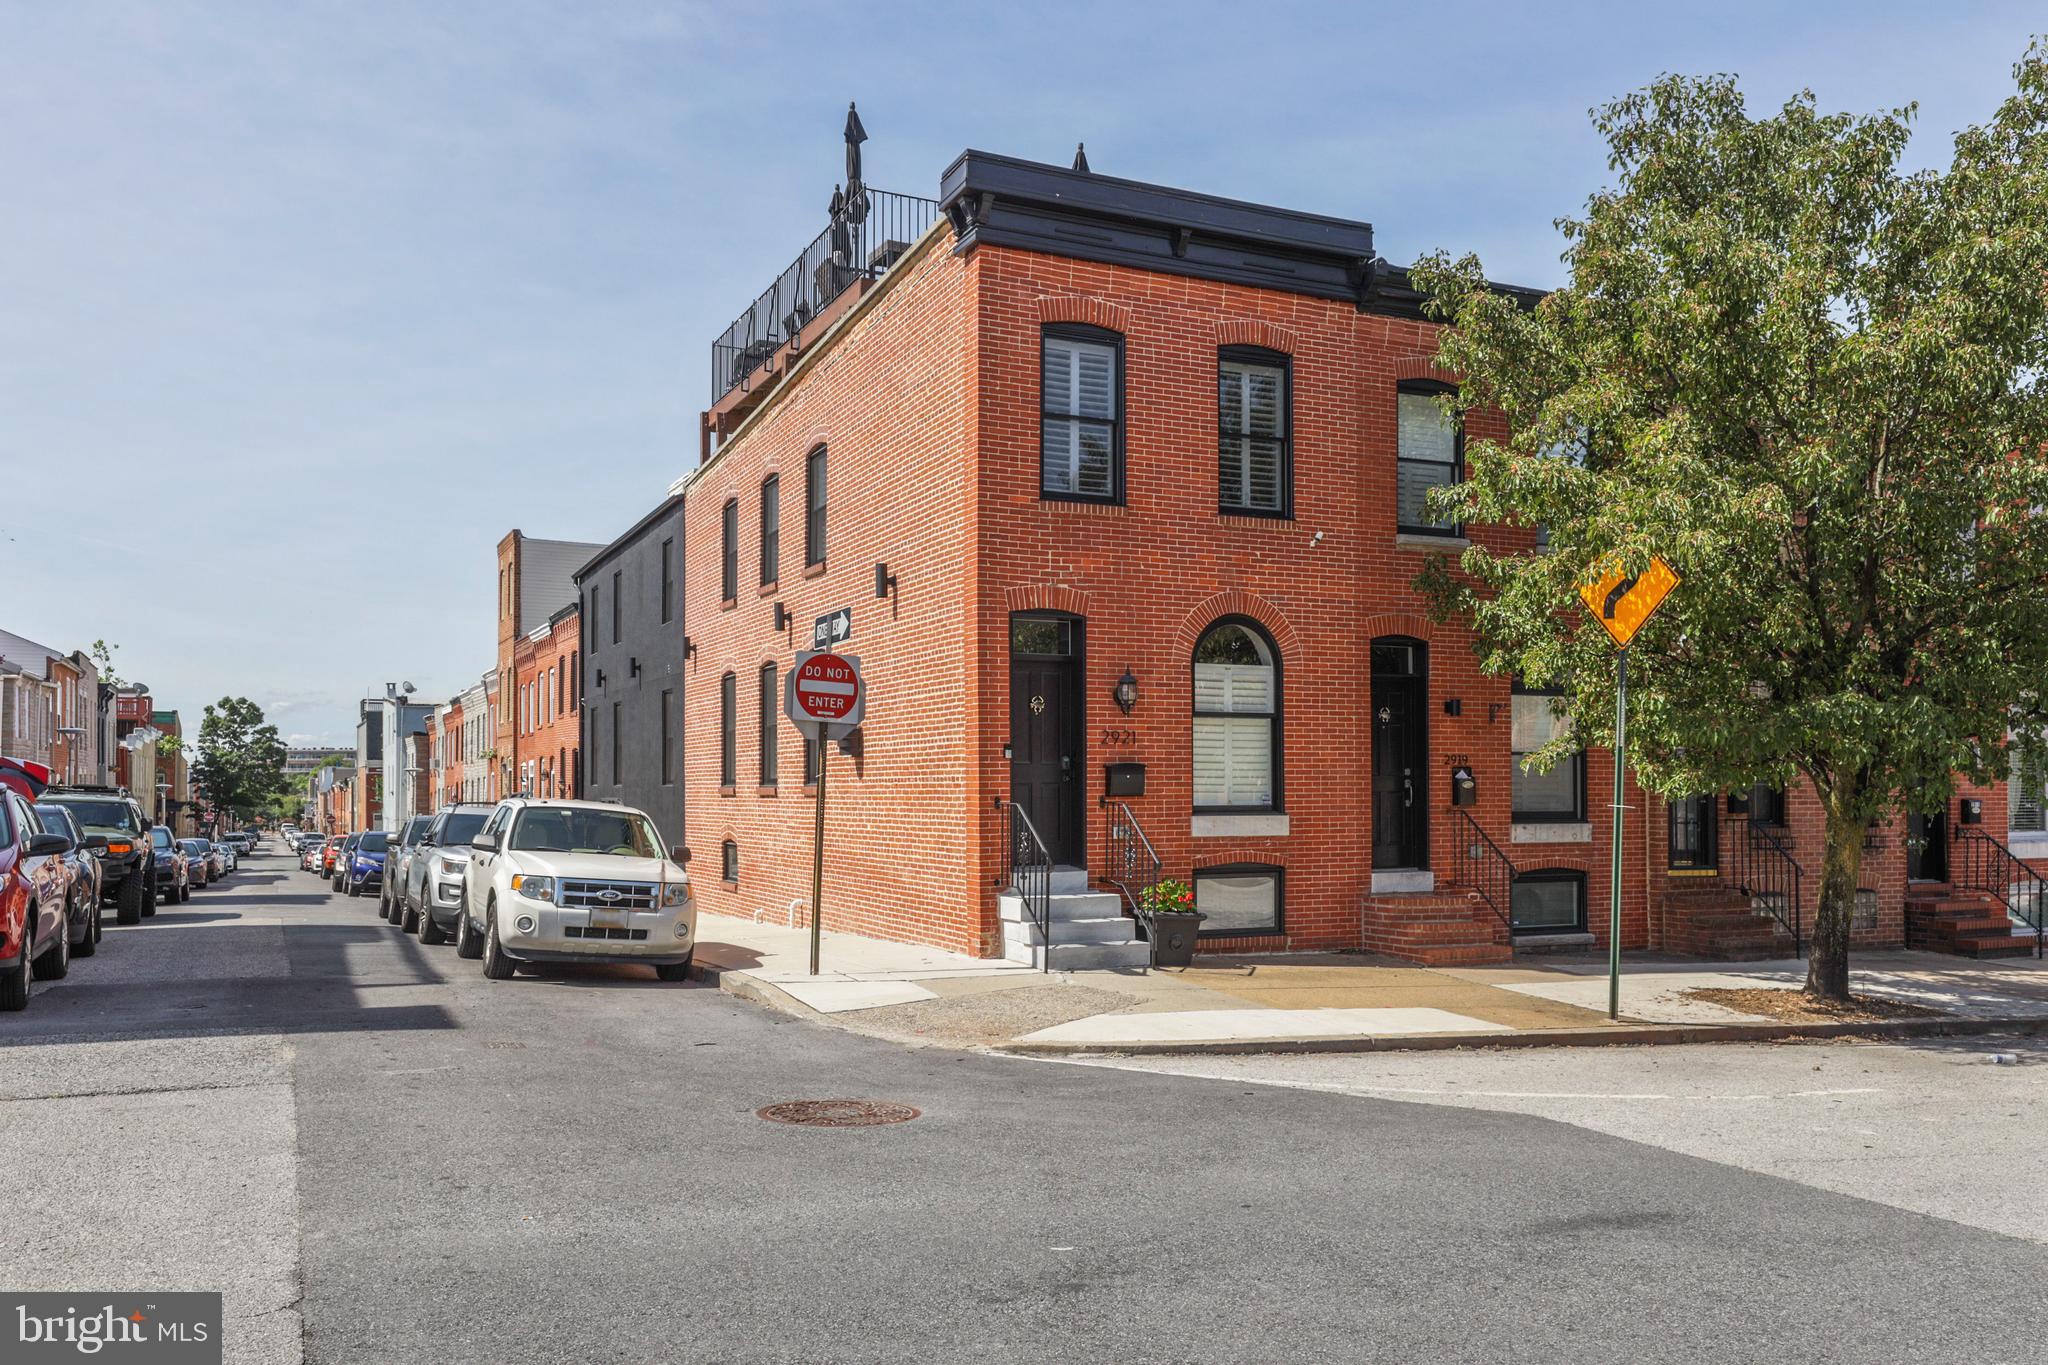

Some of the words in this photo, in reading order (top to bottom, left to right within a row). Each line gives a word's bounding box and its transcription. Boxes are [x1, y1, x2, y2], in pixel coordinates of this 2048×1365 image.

[805, 666, 821, 677] DO
[826, 668, 850, 680] NOT
[808, 695, 844, 709] ENTER
[1101, 730, 1136, 744] 2921
[1444, 754, 1468, 765] 2919
